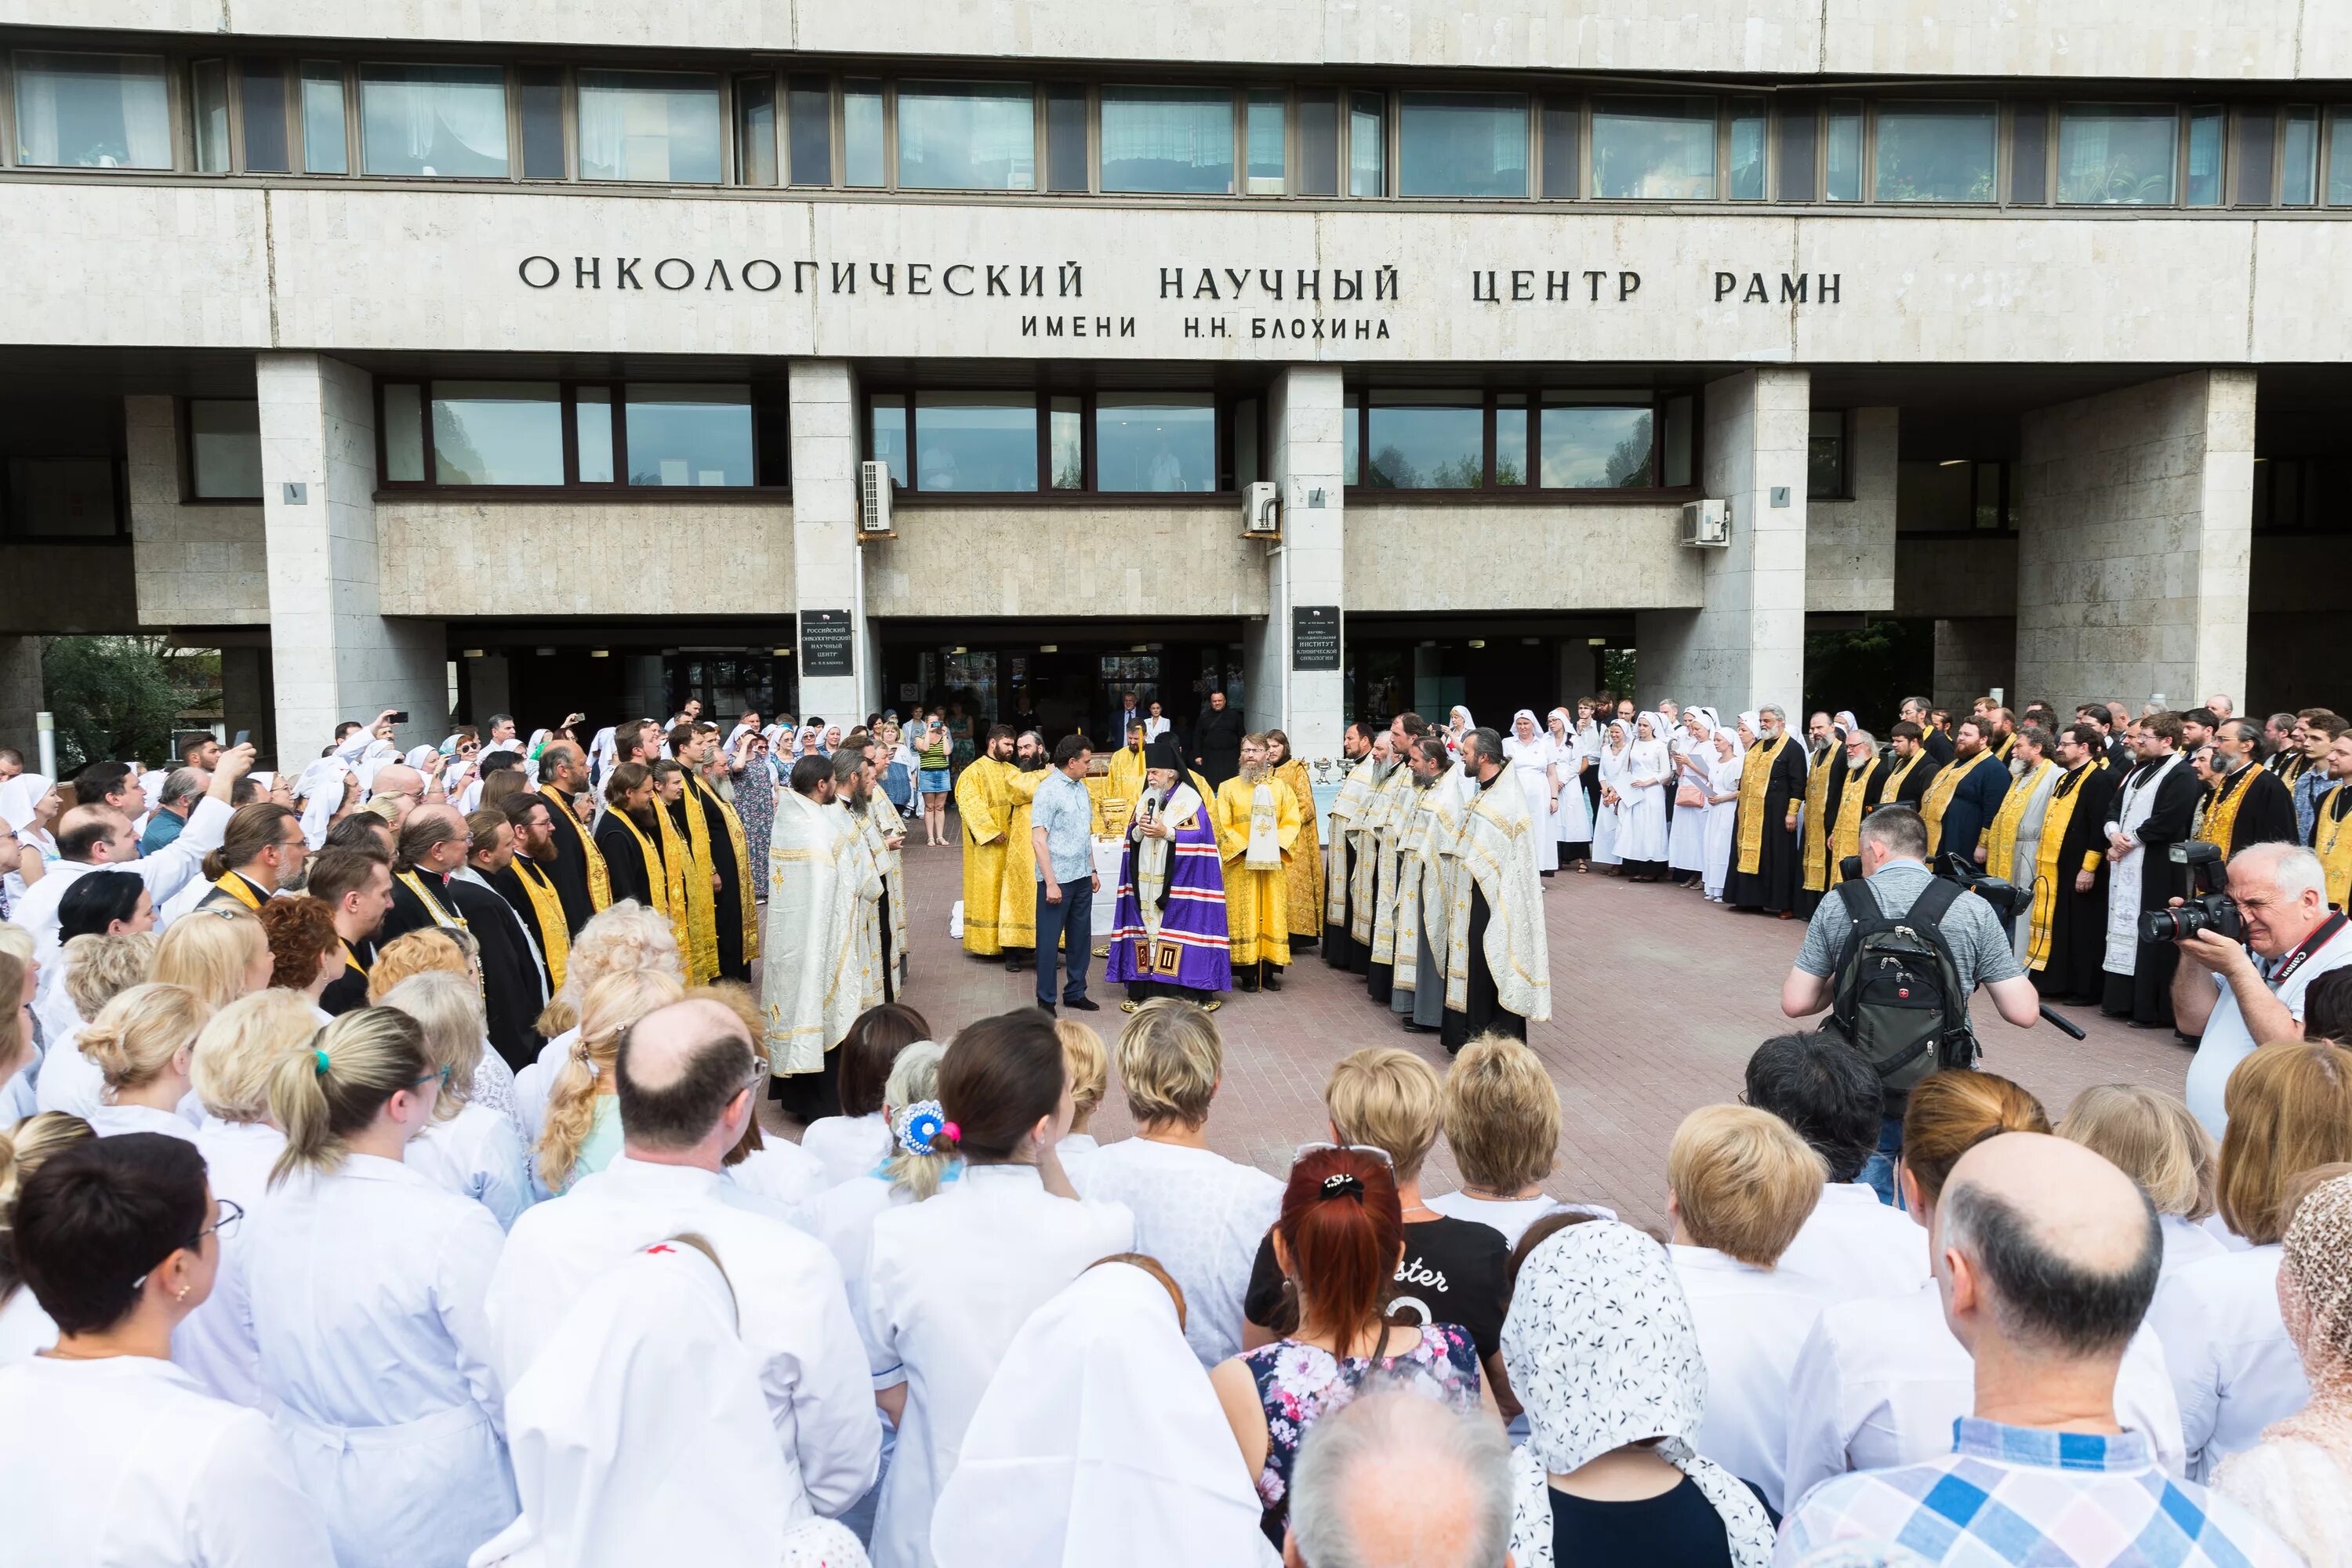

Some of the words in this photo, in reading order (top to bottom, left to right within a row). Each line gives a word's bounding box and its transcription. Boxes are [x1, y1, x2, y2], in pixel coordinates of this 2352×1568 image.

[518, 256, 1083, 297] ОНКОЛОГИЧЕСКИЙ
[1160, 264, 1399, 301] НАУЧНЫЙ
[1472, 270, 1641, 305] ЦЕНТР
[1715, 271, 1842, 304] РАМН
[1022, 315, 1134, 337] ИМЕНИ
[1185, 317, 1232, 338] Н.Н.
[1251, 318, 1390, 340] БЛОХИНА
[2281, 951, 2307, 978] Canon
[1393, 1257, 1449, 1293] ster
